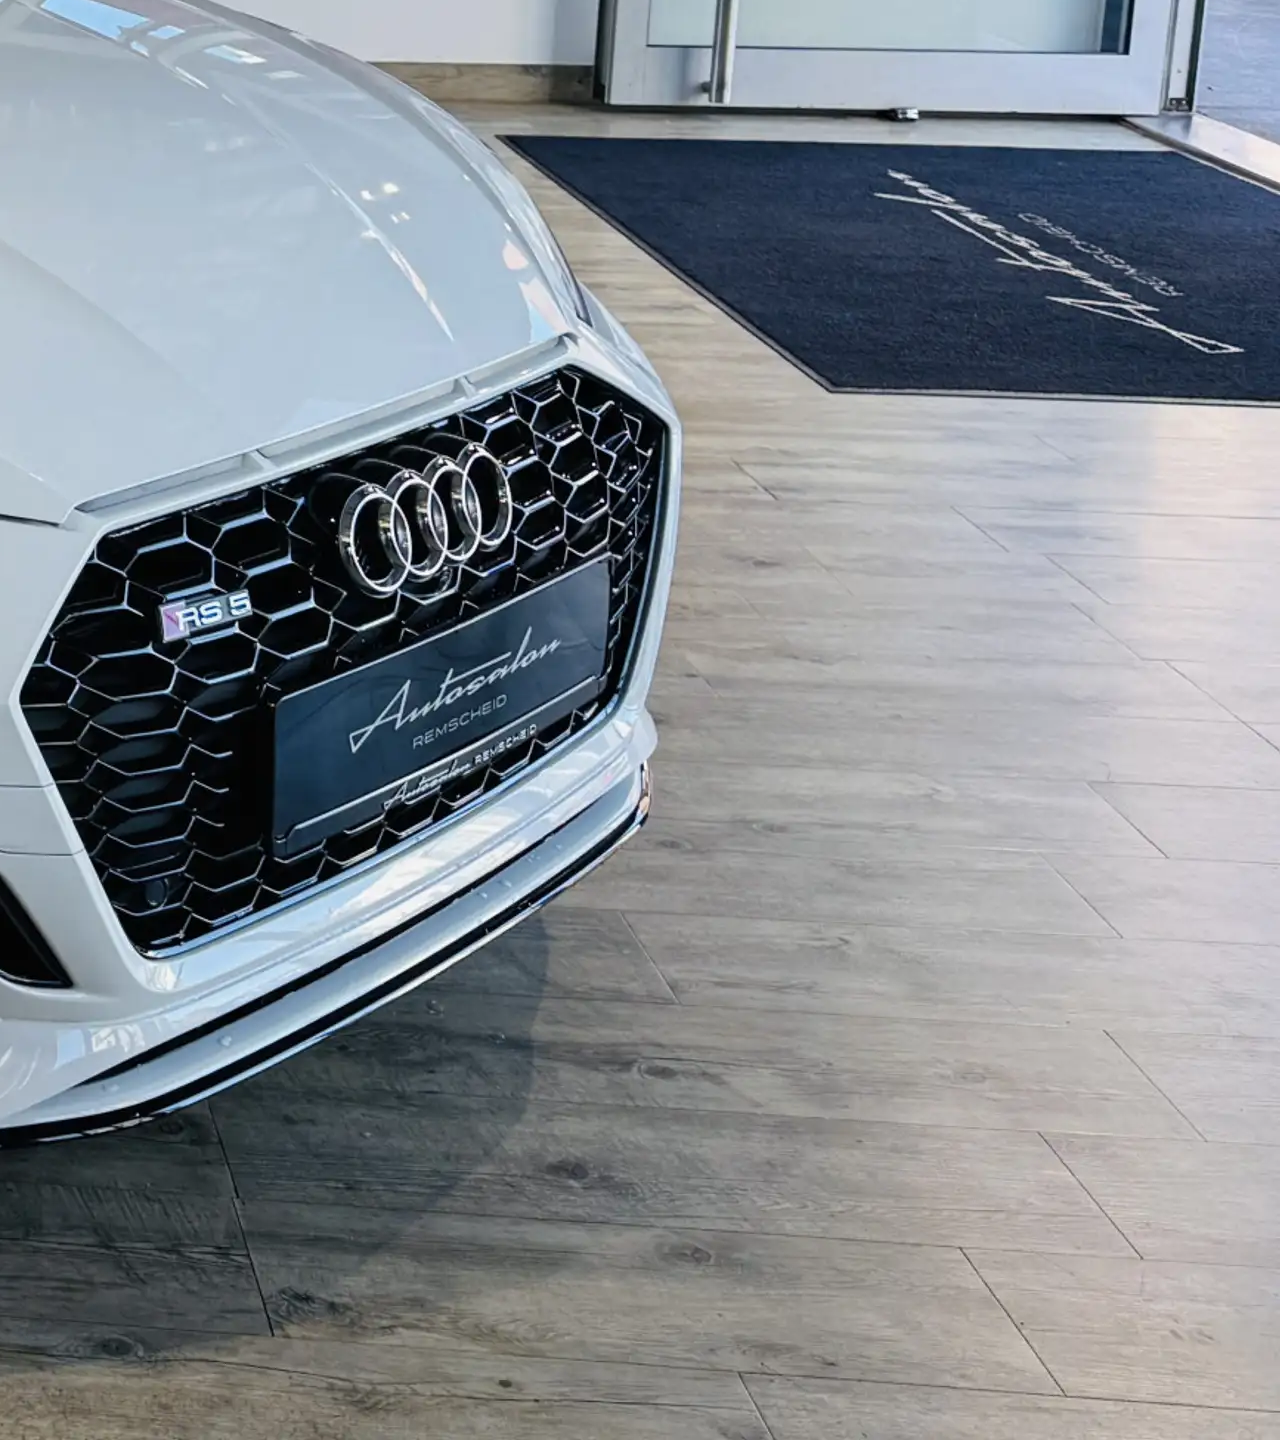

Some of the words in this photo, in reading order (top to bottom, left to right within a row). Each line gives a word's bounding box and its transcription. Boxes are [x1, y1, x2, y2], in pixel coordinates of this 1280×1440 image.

[175, 600, 223, 632] RS
[228, 592, 252, 616] 5
[348, 626, 561, 754] Autosalon
[411, 693, 508, 750] REMSCHEID
[383, 759, 471, 811] Autosalon
[474, 723, 538, 765] REMSCHEID
